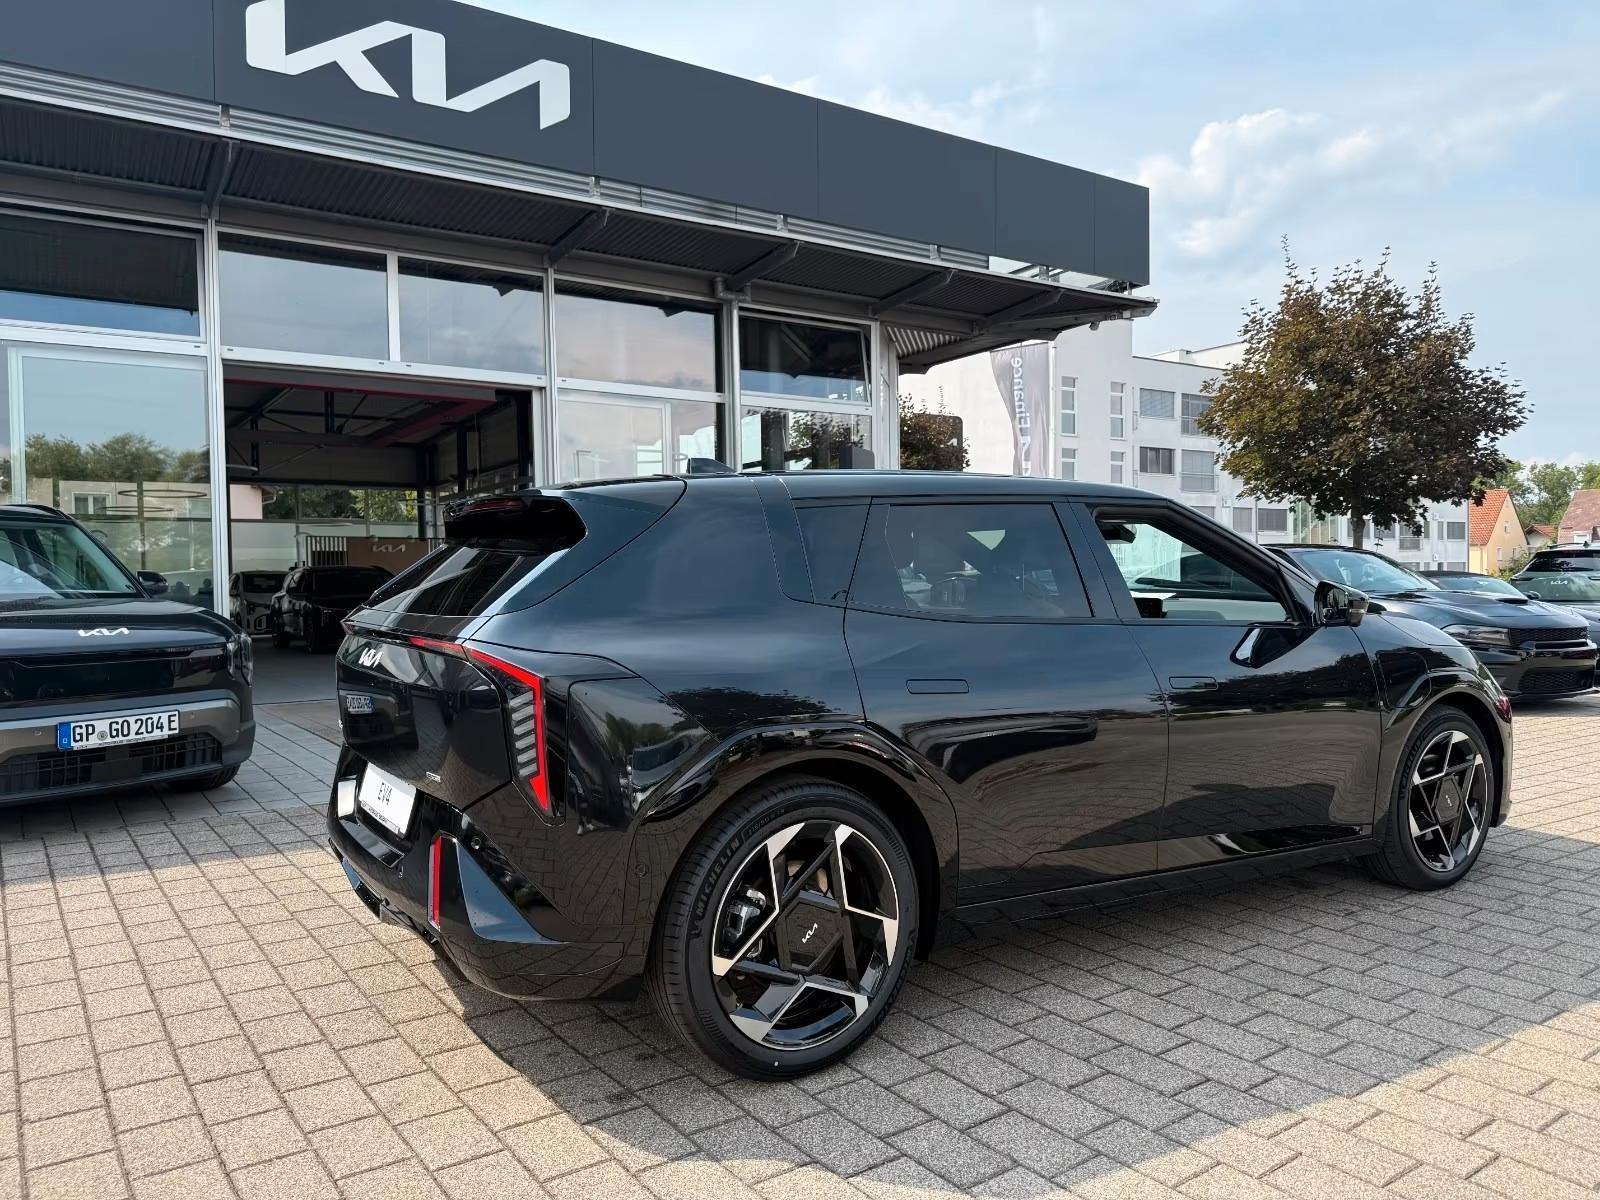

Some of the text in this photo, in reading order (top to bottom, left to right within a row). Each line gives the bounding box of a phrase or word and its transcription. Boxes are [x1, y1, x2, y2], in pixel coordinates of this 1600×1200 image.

[246, 0, 570, 130] KIA
[371, 543, 406, 553] KIA
[78, 627, 130, 636] KIA
[358, 647, 384, 669] KIA
[72, 724, 95, 743] GP
[109, 719, 131, 738] GO
[134, 716, 165, 736] 204
[167, 713, 178, 732] E
[377, 782, 393, 806] EV4
[696, 838, 740, 917] MICHELIN
[801, 922, 818, 943] KIA
